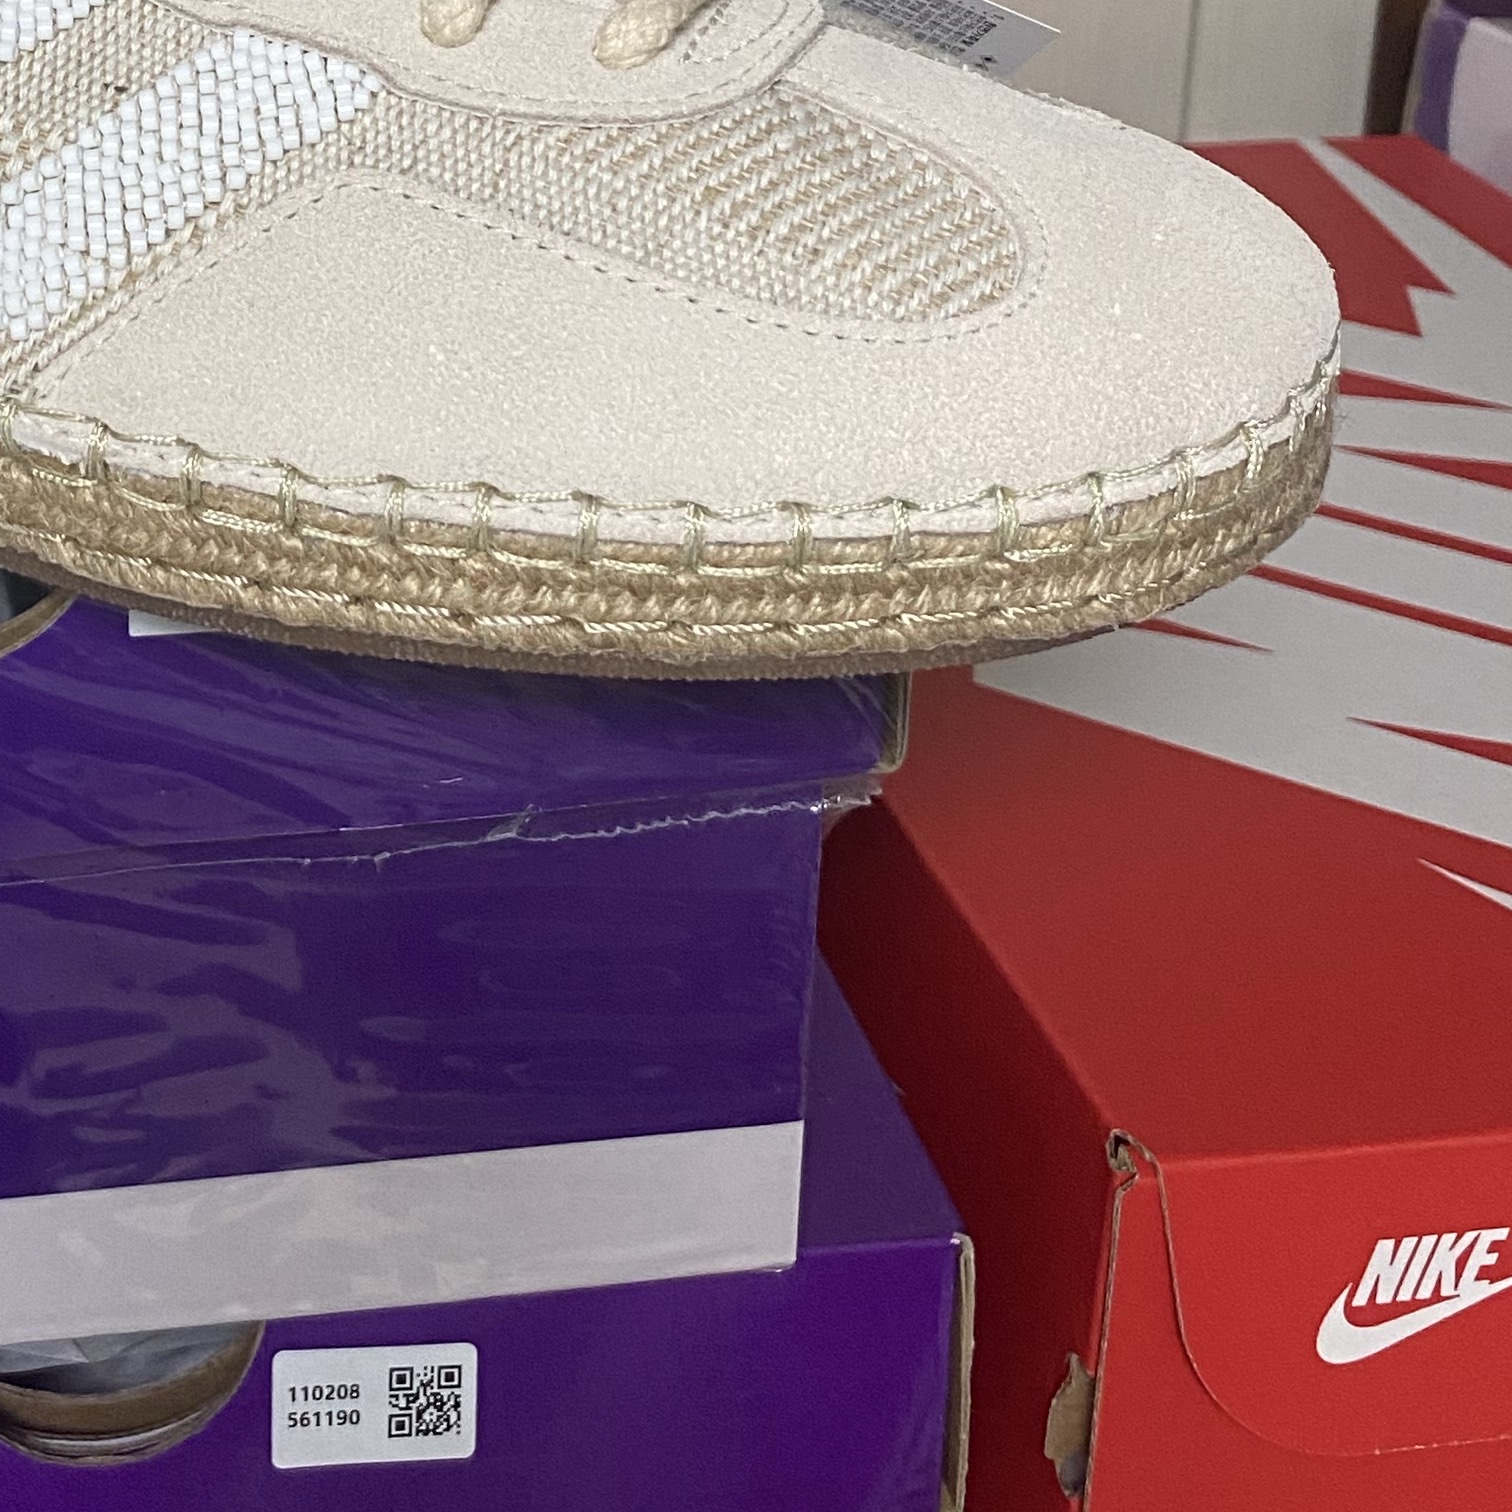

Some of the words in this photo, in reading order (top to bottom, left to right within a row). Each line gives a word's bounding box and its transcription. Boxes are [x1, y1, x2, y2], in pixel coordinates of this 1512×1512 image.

[1351, 1226, 1511, 1307] NIKE
[287, 1382, 361, 1402] 110208
[287, 1407, 361, 1428] 561190
